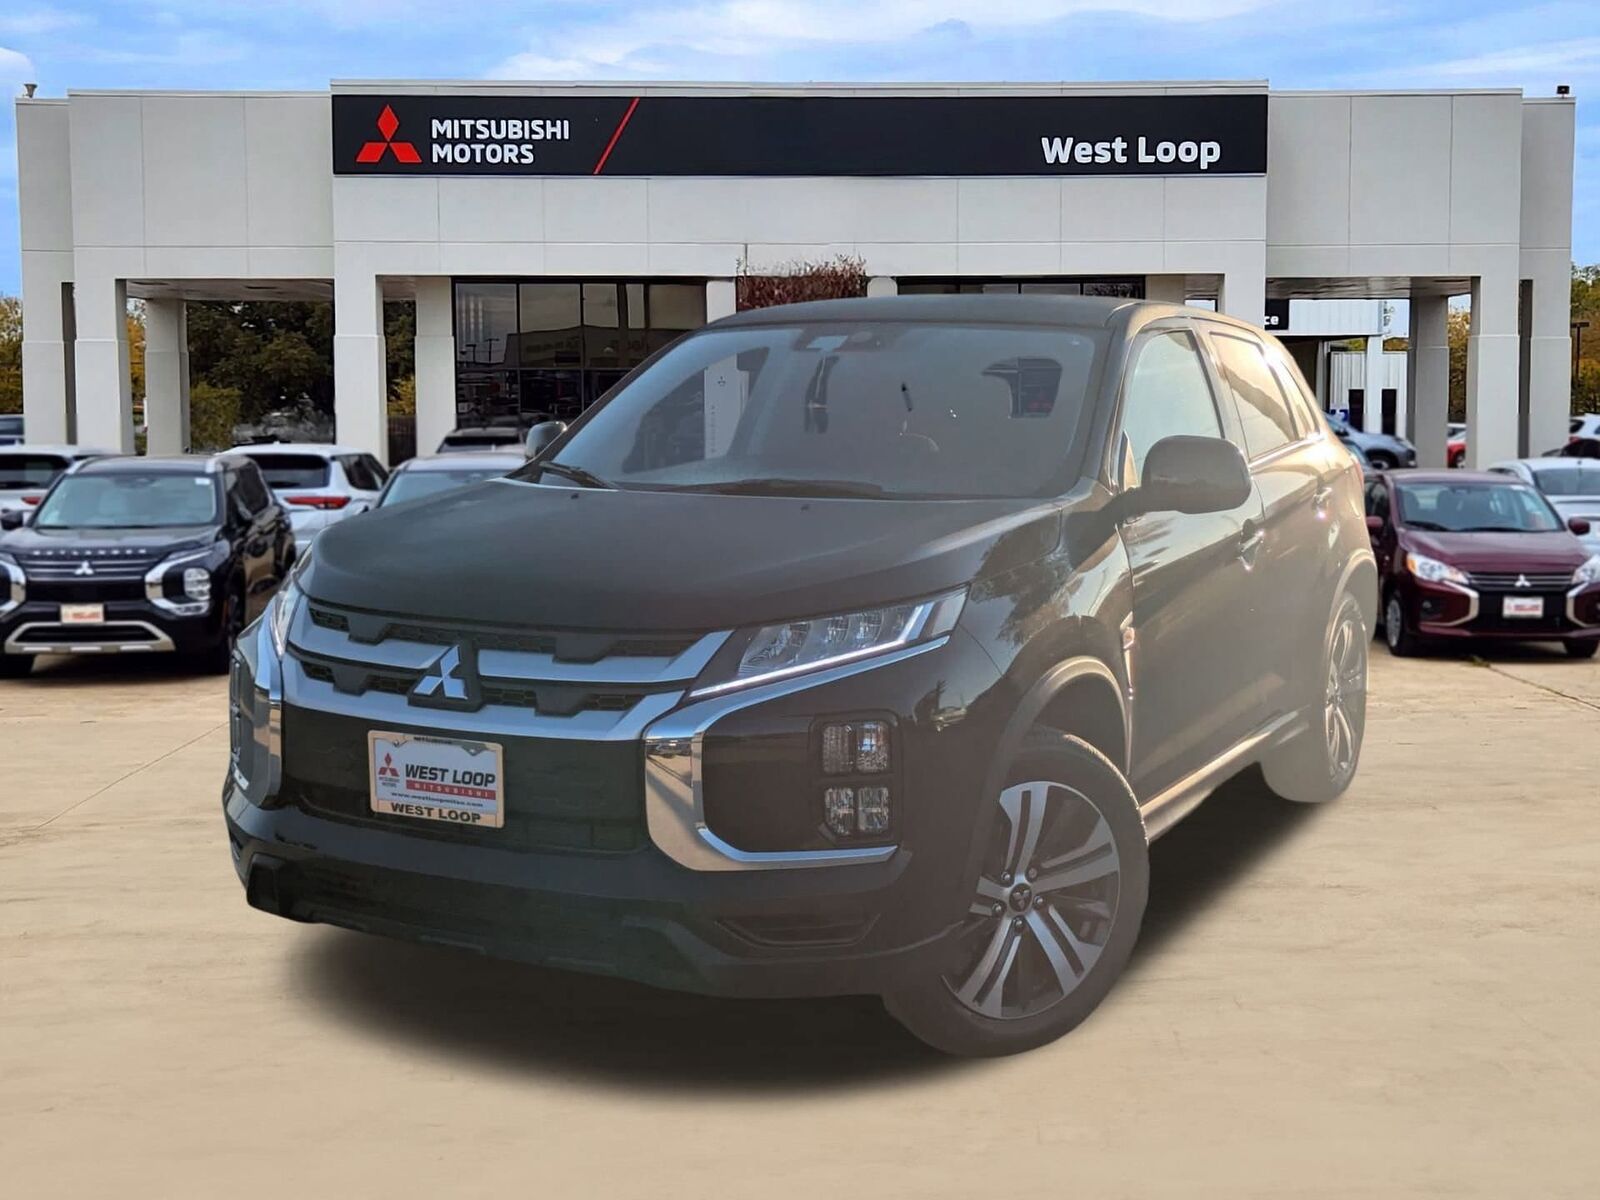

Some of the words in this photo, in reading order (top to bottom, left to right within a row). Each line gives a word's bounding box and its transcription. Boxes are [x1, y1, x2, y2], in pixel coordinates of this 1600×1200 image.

[431, 119, 569, 140] MITSUBISHI
[431, 143, 534, 164] MOTORS
[1041, 136, 1128, 164] West
[1137, 136, 1221, 169] Loop
[405, 763, 449, 783] WEST
[452, 769, 496, 787] LOOP
[391, 802, 435, 817] WEST
[438, 808, 481, 823] LOOP
